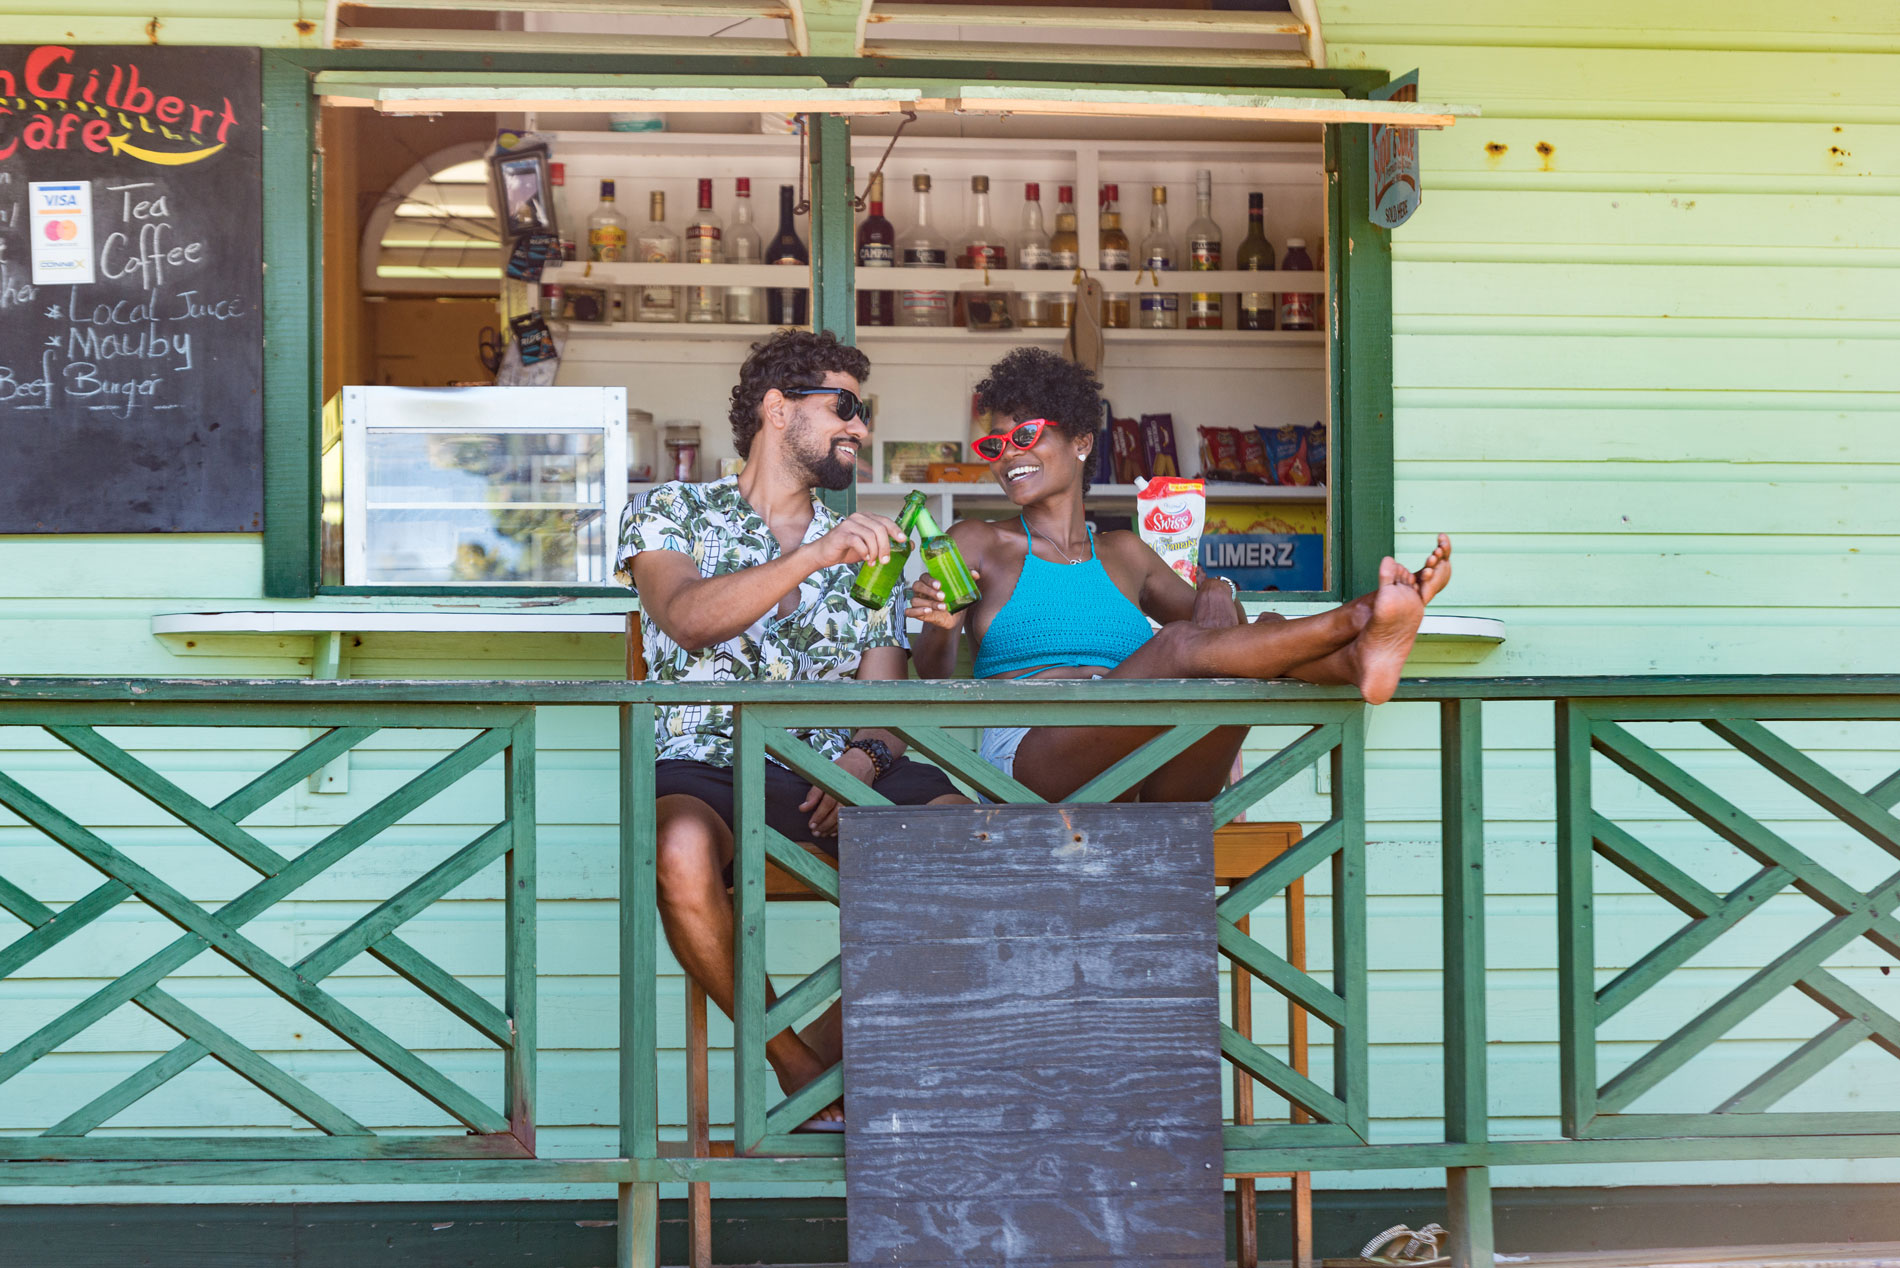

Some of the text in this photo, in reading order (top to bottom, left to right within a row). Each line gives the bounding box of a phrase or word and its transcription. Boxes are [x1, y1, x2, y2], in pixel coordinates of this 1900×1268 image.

[24, 45, 239, 144] Gilbert
[43, 194, 77, 206] VISA
[106, 182, 170, 223] Tea
[101, 223, 203, 291] Coffee
[69, 286, 245, 326] Local Juice
[67, 322, 194, 372] Mauby
[1153, 512, 1189, 532] Swiss
[1205, 543, 1293, 567] LIMERZ
